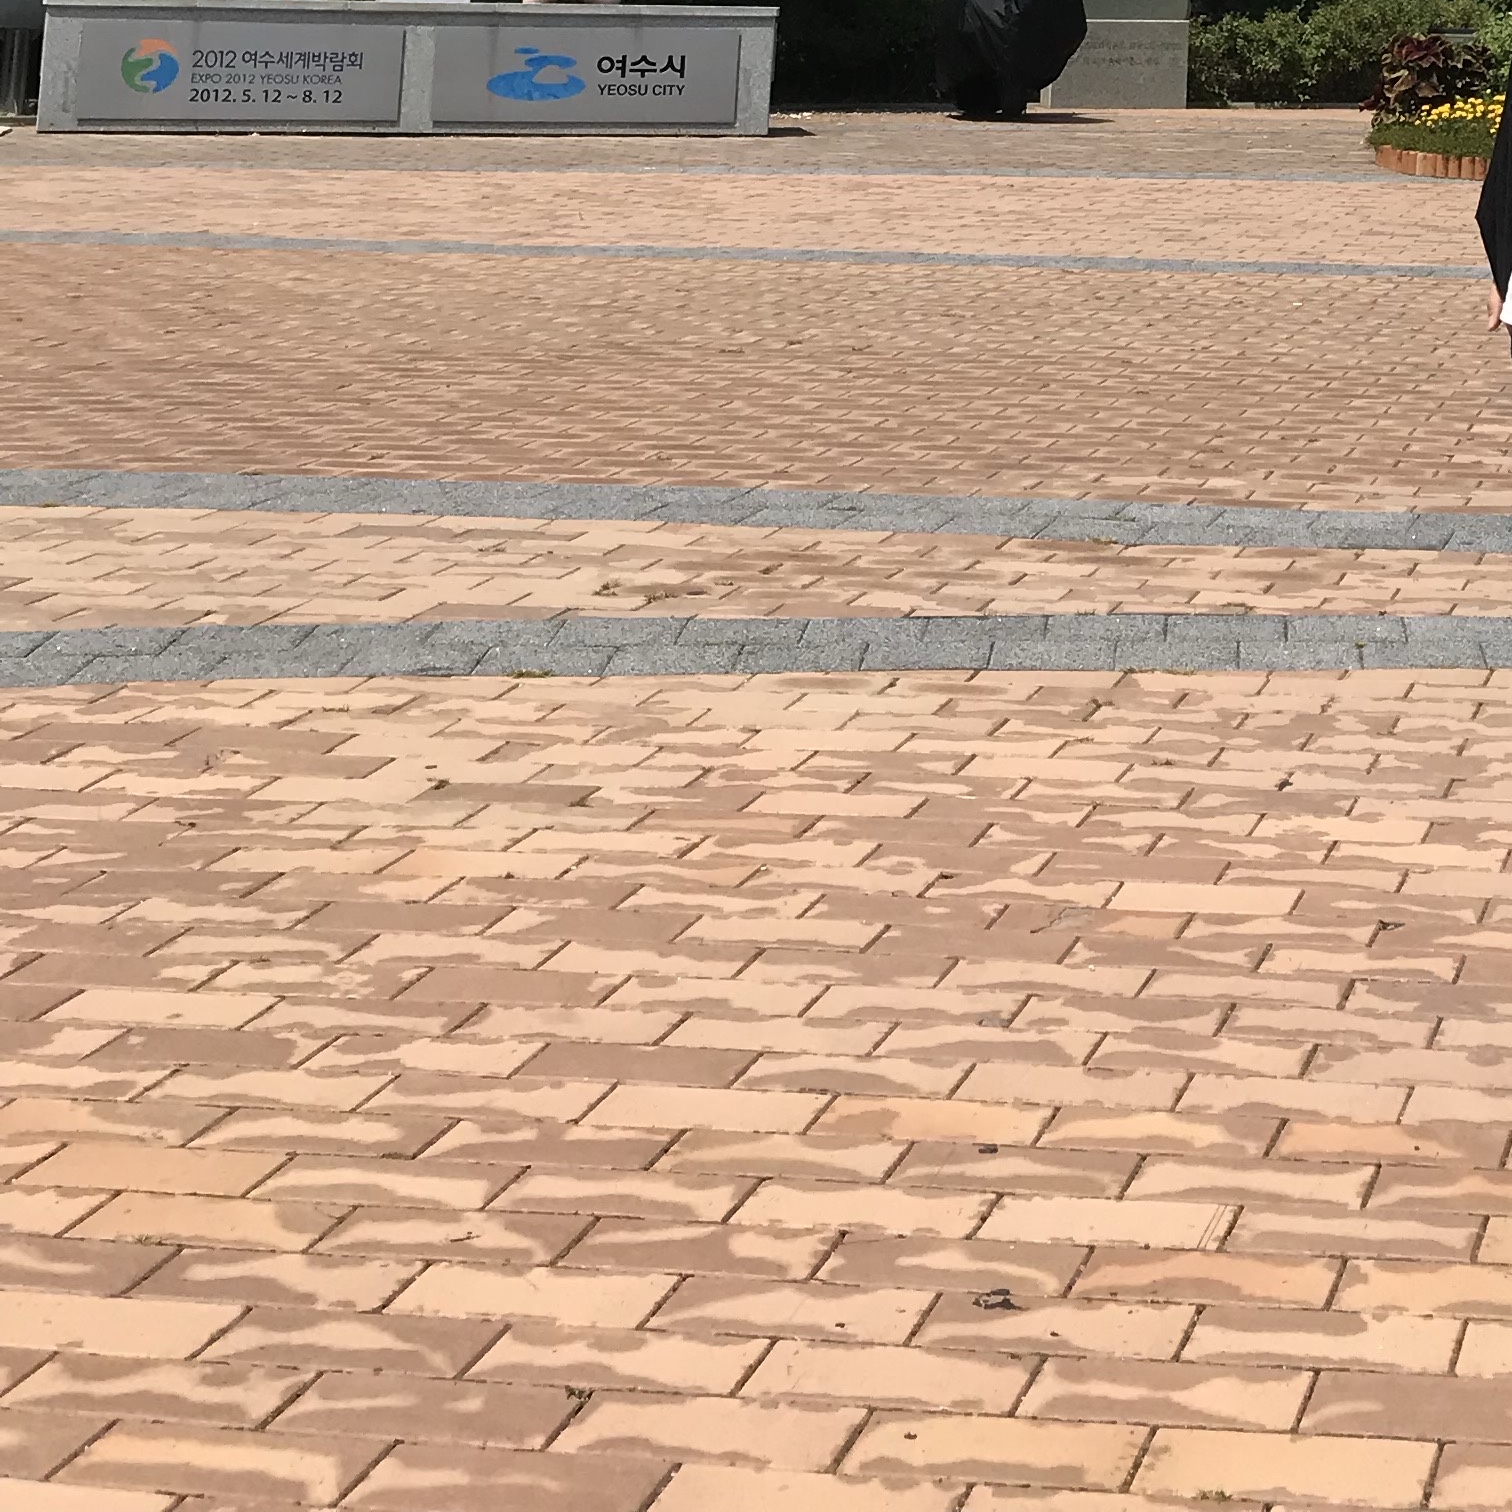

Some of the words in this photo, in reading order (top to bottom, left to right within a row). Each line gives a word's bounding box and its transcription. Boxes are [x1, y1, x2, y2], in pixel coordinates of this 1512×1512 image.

[192, 50, 237, 69] 2012
[242, 50, 364, 72] 여수세계박람회
[596, 55, 686, 79] 여수시
[191, 73, 222, 84] EXPO
[225, 73, 255, 85] 2012
[260, 73, 299, 85] YEOSU
[302, 74, 342, 85] KOREA
[262, 89, 282, 103] 12
[323, 90, 342, 104] 12
[598, 84, 648, 97] YEOSU
[652, 84, 685, 97] CITY
